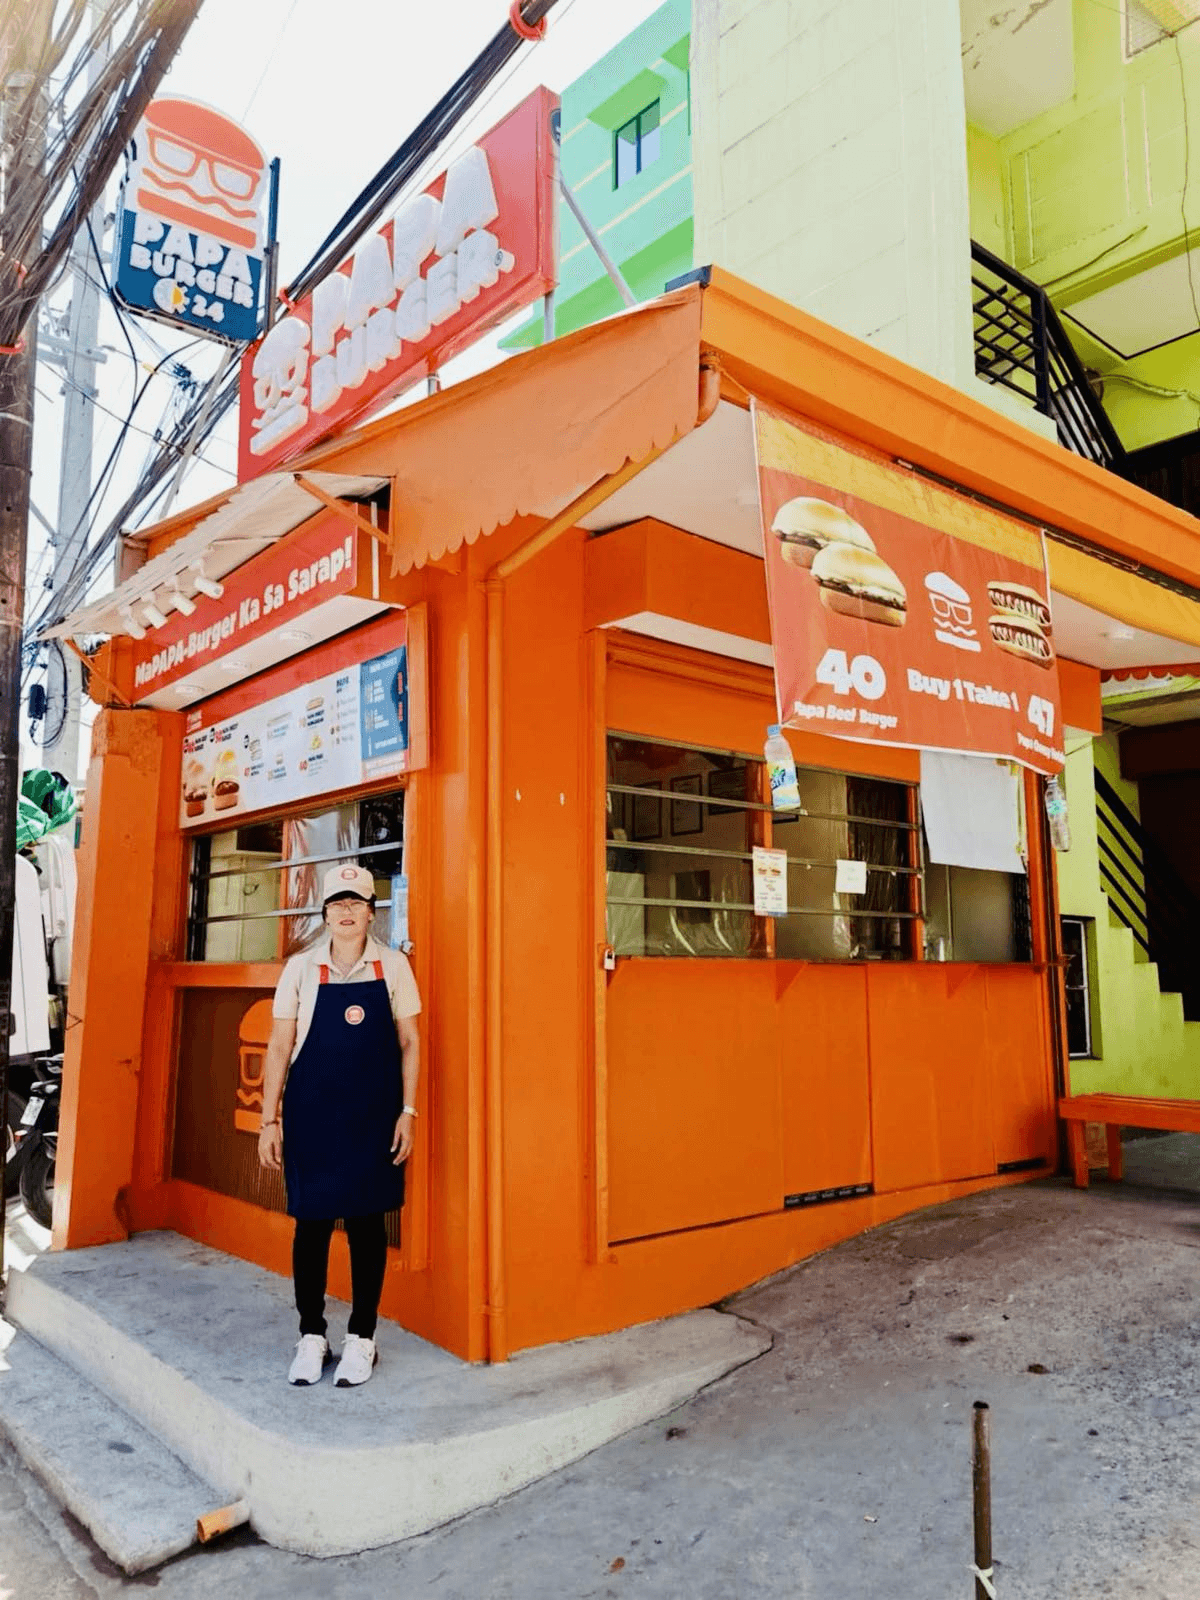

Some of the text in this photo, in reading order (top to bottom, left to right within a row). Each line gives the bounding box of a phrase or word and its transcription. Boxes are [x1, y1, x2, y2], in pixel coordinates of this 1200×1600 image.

[133, 213, 253, 286] PAPA
[311, 145, 499, 357] PAPA
[129, 243, 254, 309] BURGER
[191, 294, 225, 323] 24
[239, 597, 260, 629] Ka
[263, 584, 285, 615] Sa
[287, 535, 353, 602] Sarap!
[815, 648, 887, 700] 40
[906, 668, 951, 701] Buy
[952, 678, 965, 701] 1
[962, 680, 1013, 710] Take
[794, 700, 898, 730] Papa Beef Burger
[1027, 694, 1055, 738] 47
